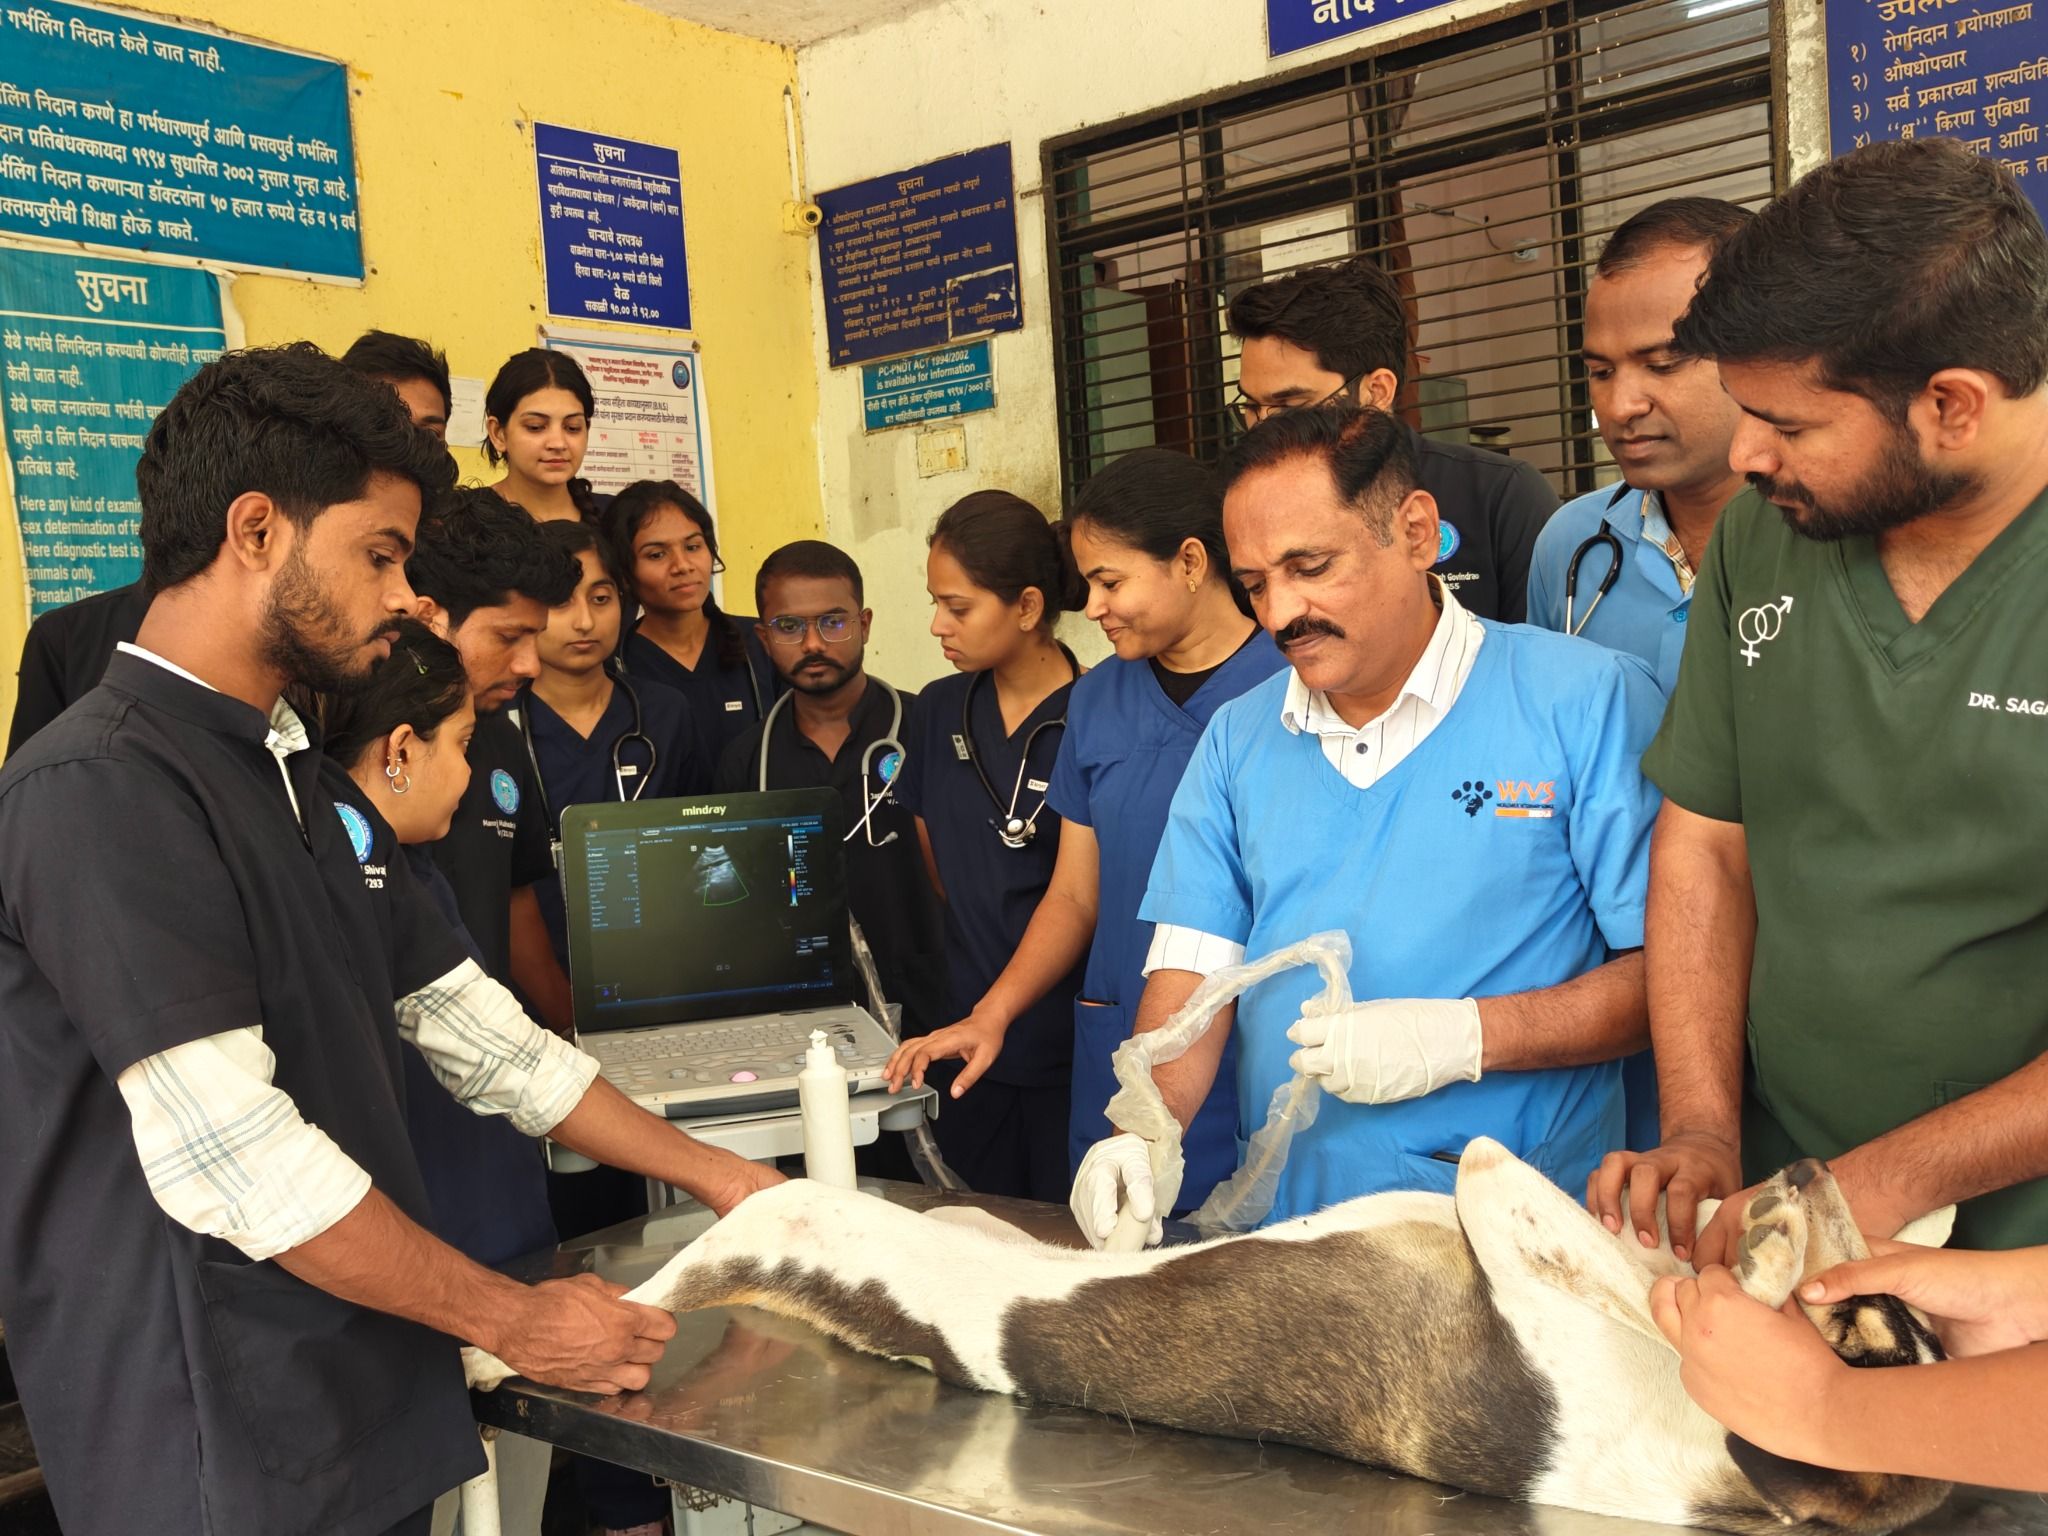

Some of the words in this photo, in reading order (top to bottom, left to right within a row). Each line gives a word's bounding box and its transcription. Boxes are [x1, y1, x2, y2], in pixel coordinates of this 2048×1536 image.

[1883, 23, 1948, 53] रोगनिदान
[1955, 3, 2033, 38] प्रयोगशाळा
[7, 7, 65, 38] गर्भलिंग
[70, 18, 115, 48] निदान
[119, 28, 149, 56] केले
[153, 41, 185, 63] जात
[189, 47, 225, 73] नाही.
[1852, 73, 1868, 91] २)
[1884, 50, 1967, 83] औषधोपचार
[1852, 103, 1869, 122] ३)
[1885, 87, 1910, 112] सर्व
[1917, 79, 1978, 108] प्रकारच्या
[1936, 110, 1975, 132] किरण
[1983, 97, 2030, 127] सुविधा
[34, 88, 77, 117] निदान
[80, 100, 115, 124] करणे
[119, 108, 133, 131] हा
[214, 124, 245, 148] आणि
[297, 139, 338, 165] गर्भलिंग
[1965, 137, 1991, 155] दान
[1999, 123, 2039, 149] आणि
[0, 124, 24, 144] दान
[132, 147, 166, 169] १९९४
[170, 153, 219, 178] सुधारित
[223, 162, 254, 185] २००२
[258, 169, 290, 192] नुसार
[293, 174, 319, 198] गुन्हा
[324, 176, 350, 201] आहे.
[593, 142, 625, 163] सुचना
[41, 160, 82, 190] निदान
[148, 179, 205, 209] डॉक्टरांना
[211, 194, 227, 212] ५०
[231, 197, 263, 218] हजार
[266, 200, 295, 222] रुपये
[298, 202, 315, 227] दंड
[317, 211, 326, 227] व
[329, 212, 338, 230] ५
[897, 176, 924, 195] सुचना
[81, 203, 117, 230] शिक्षा
[158, 218, 199, 242] शकते.
[75, 269, 148, 313] सुचना
[613, 282, 630, 300] वेळ
[584, 298, 608, 313] सकाळी
[4, 329, 22, 350] येथे
[25, 331, 53, 352] गर्भाचे
[55, 333, 103, 357] लिंगनिदान
[105, 340, 146, 360] करण्याची
[150, 341, 189, 366] कोणतीही
[7, 360, 30, 383] केली
[33, 367, 55, 382] जात
[58, 365, 84, 388] नाही.
[914, 358, 929, 369] ACT
[877, 380, 883, 390] is
[884, 374, 916, 389] available
[918, 372, 928, 382] for
[10, 392, 27, 414] येथे
[31, 398, 57, 415] फक्त
[59, 397, 110, 418] जनावरांच्या
[115, 398, 145, 420] गर्भाची
[45, 431, 53, 445] व
[56, 425, 76, 446] लिंग
[79, 426, 106, 448] निदान
[55, 456, 80, 477] आहे.
[20, 495, 46, 512] Here
[48, 498, 68, 516] any
[70, 496, 92, 512] kind
[94, 497, 105, 512] of
[107, 497, 143, 512] examin
[22, 521, 42, 534] sex
[44, 518, 115, 535] determination
[118, 519, 128, 535] of
[25, 541, 51, 557] Here
[53, 541, 106, 561] diagnostic
[109, 543, 128, 558] test
[130, 542, 139, 557] is
[27, 563, 69, 580] animals
[71, 563, 96, 584] only.
[30, 586, 74, 603] Prenatal
[1968, 692, 2000, 710] DR.
[1496, 780, 1555, 803] WVS
[682, 804, 727, 817] mindray
